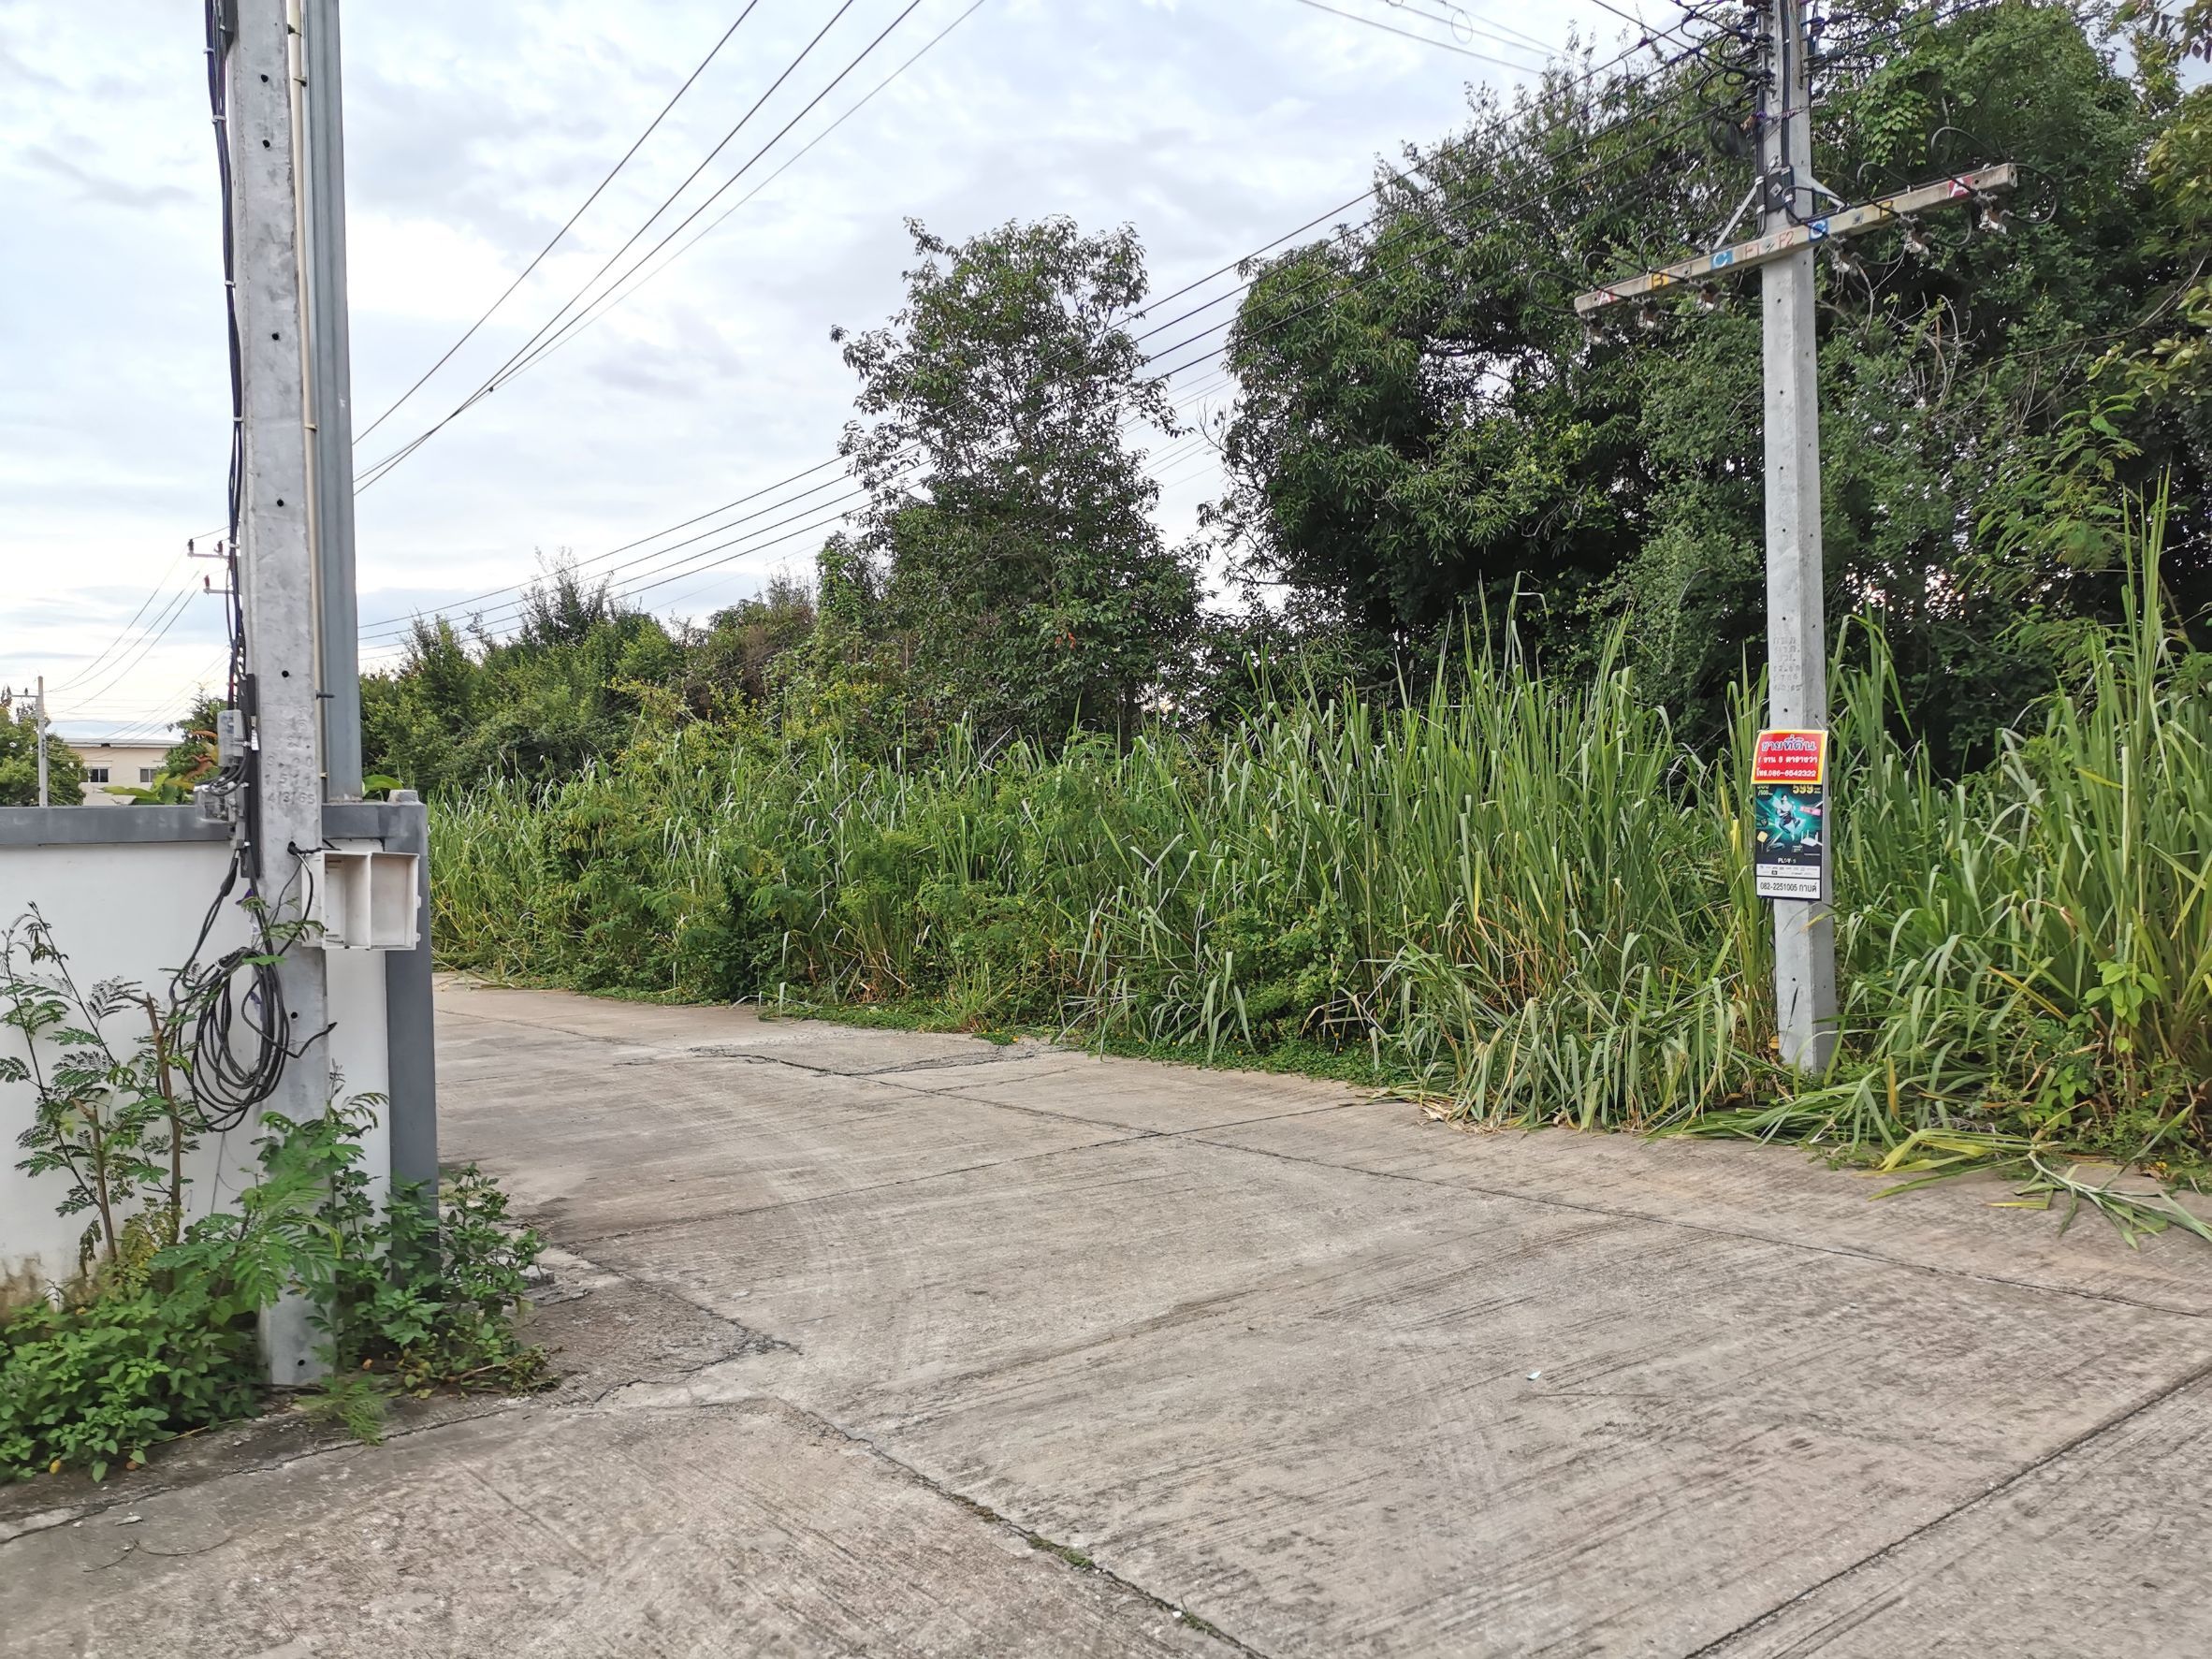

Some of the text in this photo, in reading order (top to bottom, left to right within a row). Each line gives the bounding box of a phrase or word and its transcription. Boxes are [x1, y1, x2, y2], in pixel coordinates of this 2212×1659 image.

[1713, 252, 1727, 268] C
[1779, 231, 1794, 247] F2
[1762, 734, 1816, 751] ขายที่ดิน
